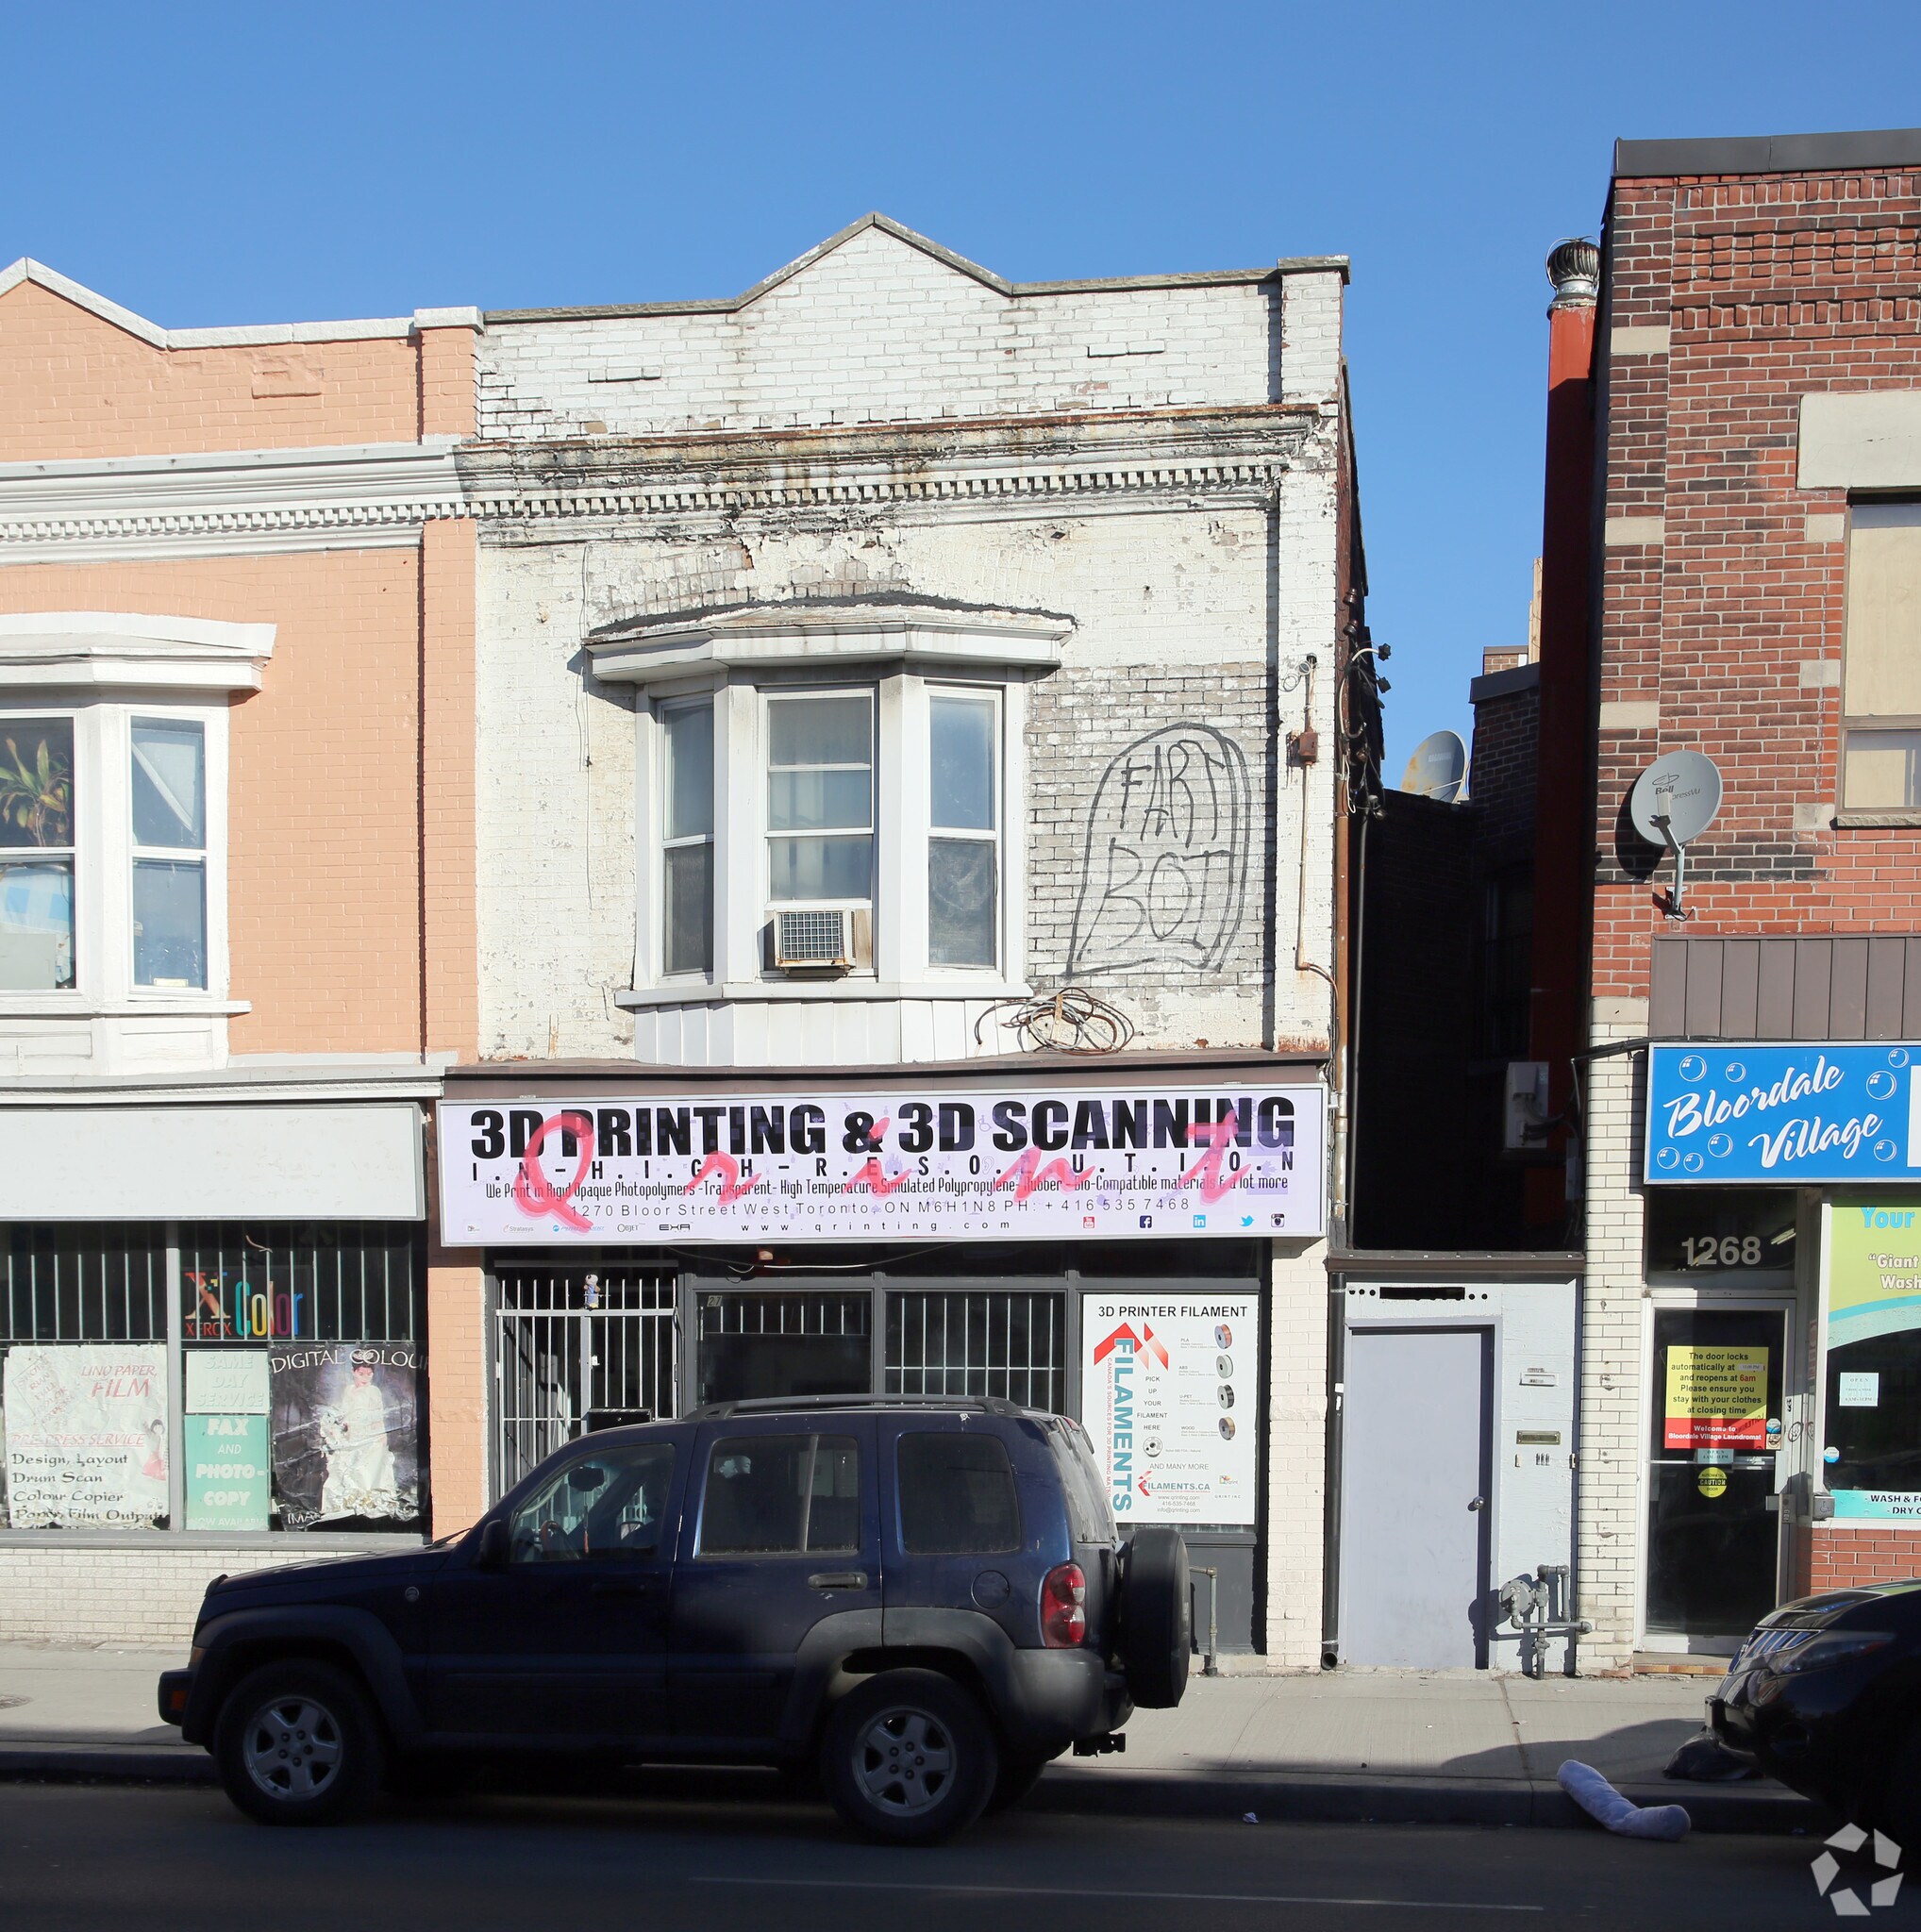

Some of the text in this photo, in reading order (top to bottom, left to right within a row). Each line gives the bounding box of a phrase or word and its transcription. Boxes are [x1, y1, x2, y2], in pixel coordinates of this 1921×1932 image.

[1120, 739, 1226, 849] FART
[1655, 785, 1675, 796] Bell
[1077, 838, 1232, 962] BOT
[1662, 1055, 1845, 1139] Bloordale
[471, 1096, 1295, 1159] 3D PRINTING & 3D SCANNING
[1747, 1112, 1884, 1169] Village
[486, 1183, 501, 1198] We
[504, 1183, 531, 1198] Print
[534, 1184, 543, 1198] in
[546, 1182, 571, 1201] Rigid
[574, 1182, 612, 1201] Opaque
[615, 1181, 695, 1201] Photopolymers
[780, 1179, 802, 1199] High
[807, 1178, 877, 1198] Temperature
[881, 1177, 935, 1193] Simulated
[1025, 1177, 1062, 1191] Rubber
[1075, 1174, 1158, 1194] Bio-Compatible
[1161, 1173, 1215, 1191] materials
[1240, 1175, 1255, 1189] lot
[1258, 1176, 1289, 1189] more
[572, 1205, 613, 1217] 1270
[621, 1204, 671, 1217] Bloor
[677, 1203, 737, 1216] Street
[743, 1203, 789, 1215] West
[884, 1201, 910, 1213] ON
[918, 1200, 996, 1213] M6H1N8
[1860, 1206, 1915, 1228] Your
[742, 1221, 1010, 1232] www.qrinting.com
[1681, 1237, 1762, 1266] 1268
[235, 1280, 304, 1337] Color
[1098, 1306, 1248, 1317] 3D PRINTER FILAMENT
[204, 1354, 253, 1369] SAME
[271, 1350, 345, 1374] DIGITAL
[1689, 1352, 1748, 1360] The door locks
[81, 1365, 158, 1377] LINO PAPER,
[1671, 1363, 1725, 1372] automatically
[210, 1374, 247, 1388] DAY
[1695, 1374, 1729, 1383] reopens
[1739, 1374, 1756, 1382] 6am
[92, 1378, 151, 1398] FILM
[1680, 1384, 1707, 1392] Please
[195, 1391, 265, 1407] SERVICE
[1673, 1395, 1690, 1404] stay
[1696, 1407, 1727, 1415] closing
[207, 1419, 249, 1436] FAX
[1112, 1339, 1134, 1511] FILAMENTS
[88, 1434, 145, 1445] SERVICE
[217, 1444, 242, 1455] AND
[11, 1454, 129, 1469] Design, Layout
[12, 1471, 103, 1483] Drum Scan
[195, 1463, 265, 1479] PHOTO-
[13, 1490, 125, 1504] Colour Copier
[203, 1491, 252, 1507] COPY
[1870, 1494, 1901, 1503] WASH
[1903, 1494, 1911, 1503] &
[68, 1507, 100, 1520] Film
[1893, 1507, 1913, 1515] DRY
